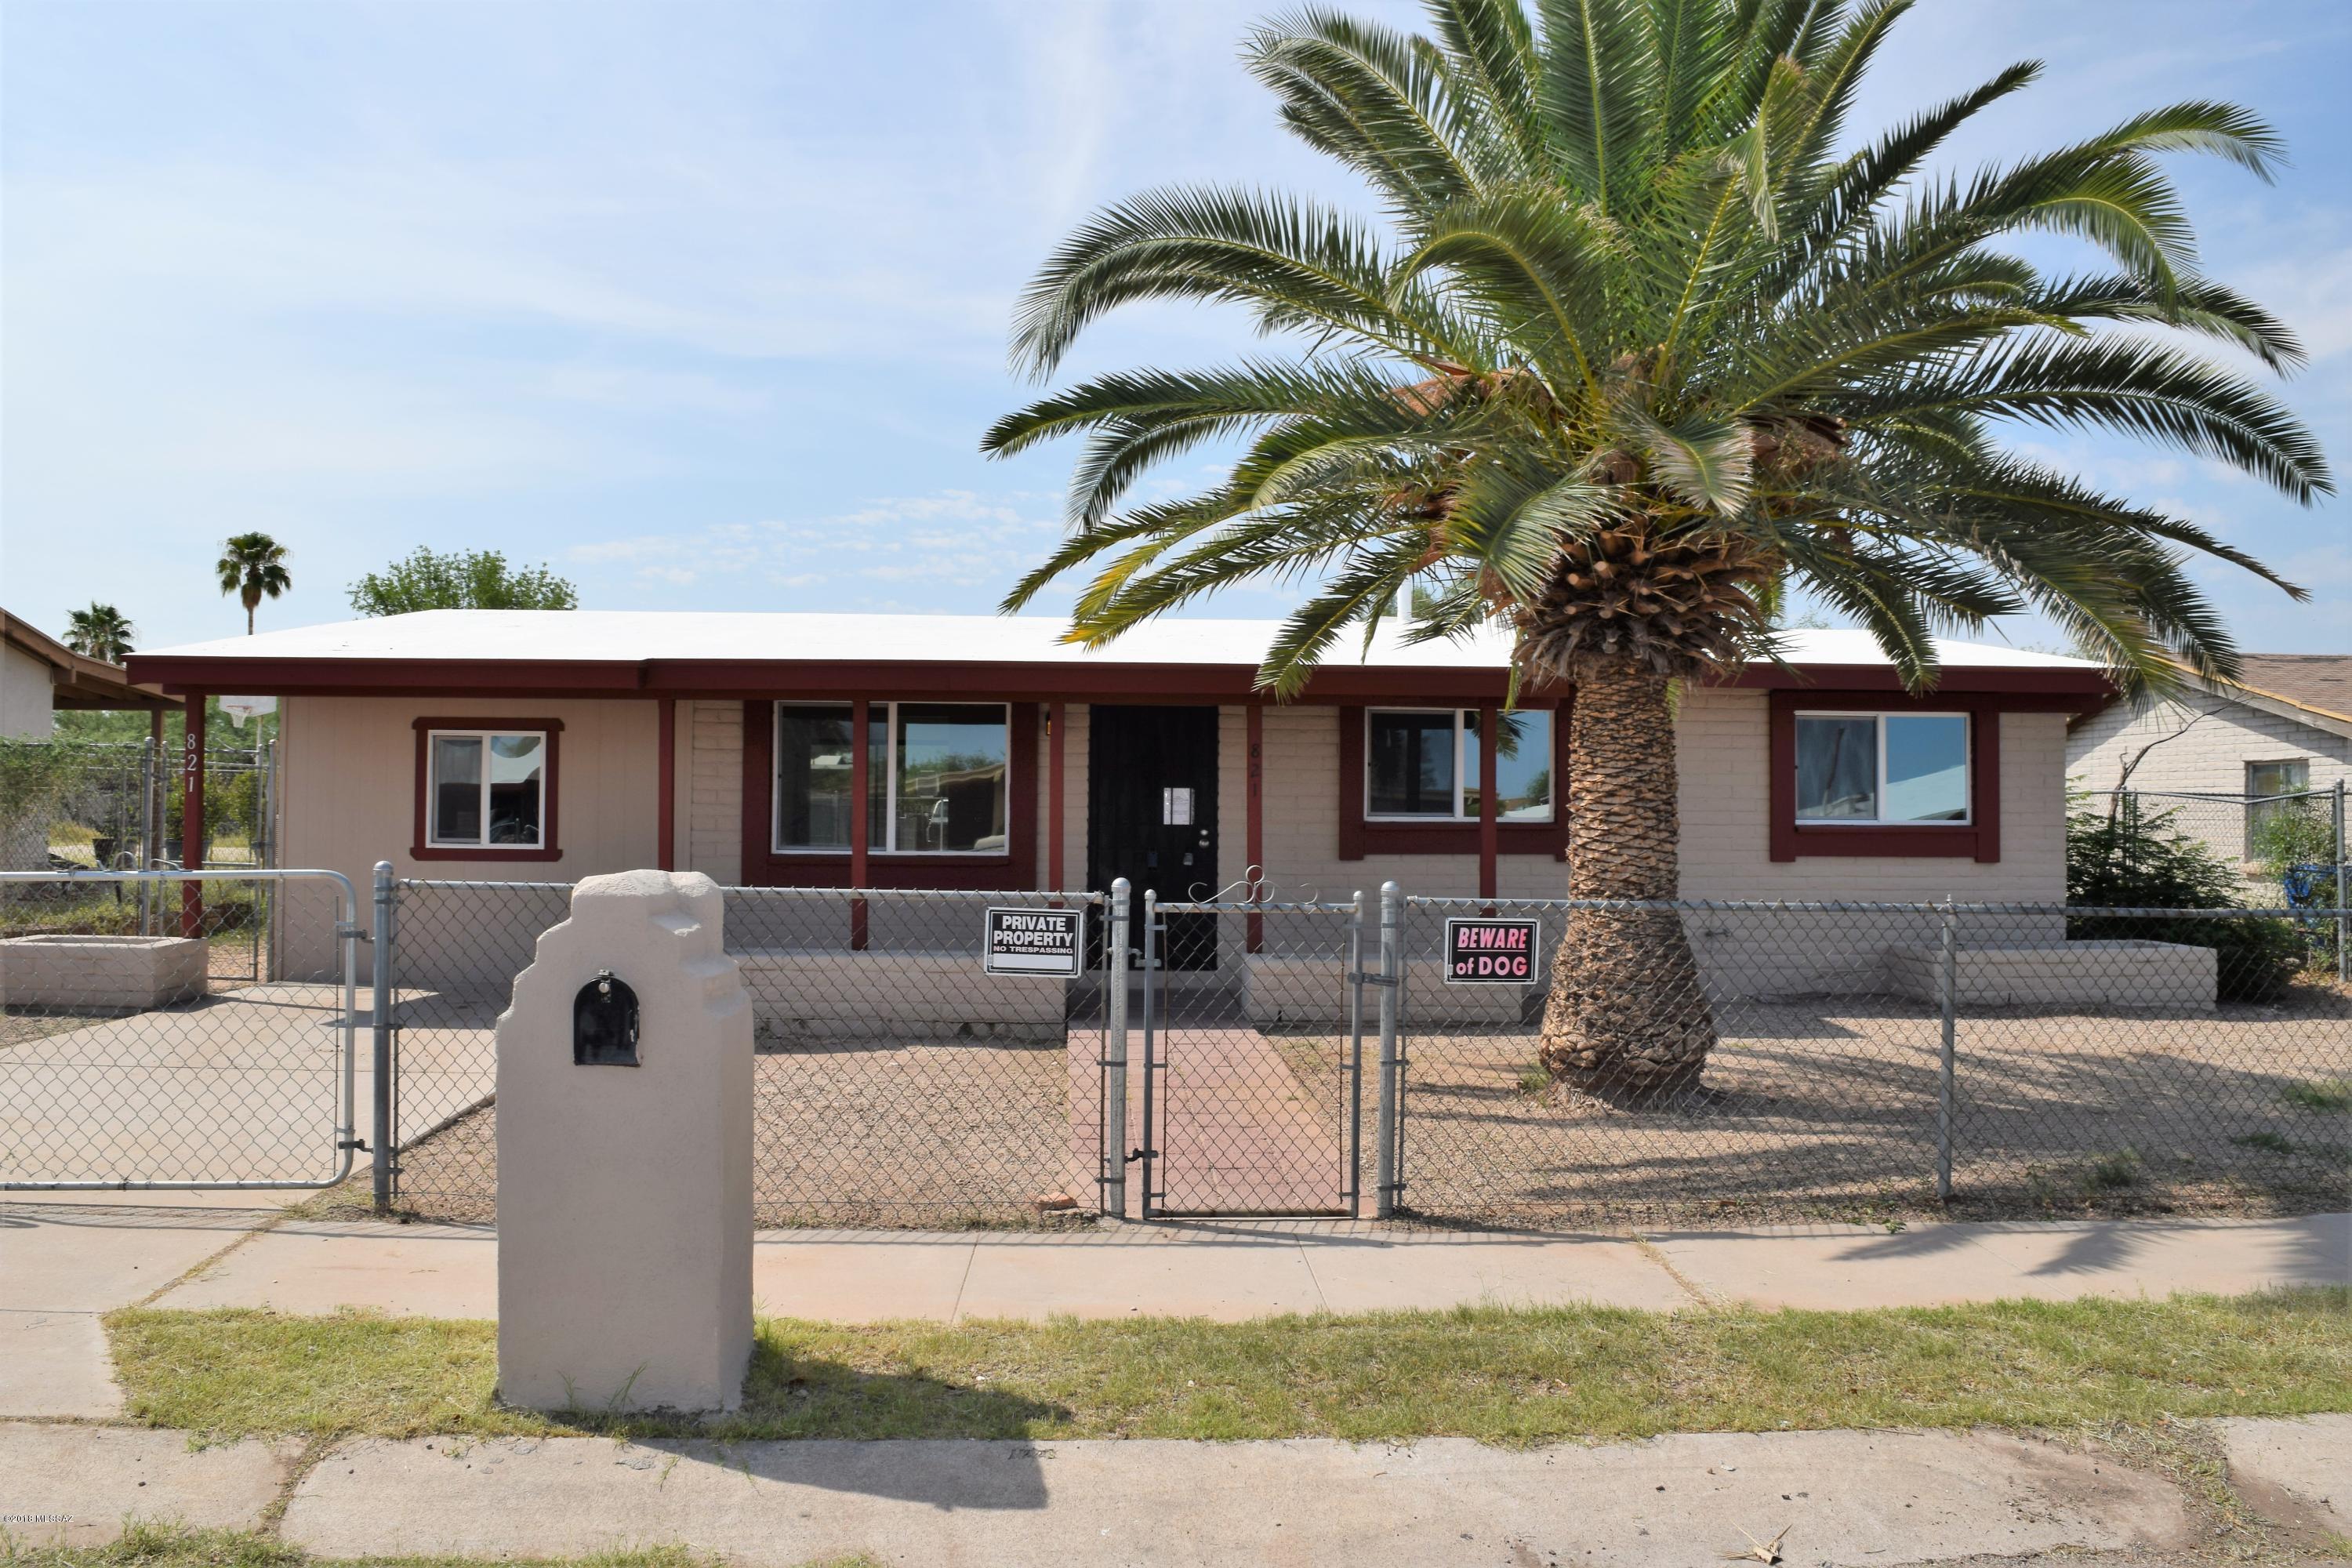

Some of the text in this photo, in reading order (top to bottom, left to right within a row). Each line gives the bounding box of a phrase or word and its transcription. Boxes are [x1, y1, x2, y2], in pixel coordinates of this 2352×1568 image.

[187, 734, 197, 792] 821
[1002, 915, 1066, 931] PRIVATE
[993, 931, 1073, 946] PROPERTY
[1457, 927, 1528, 949] BEWARE
[1456, 956, 1527, 976] of DOG
